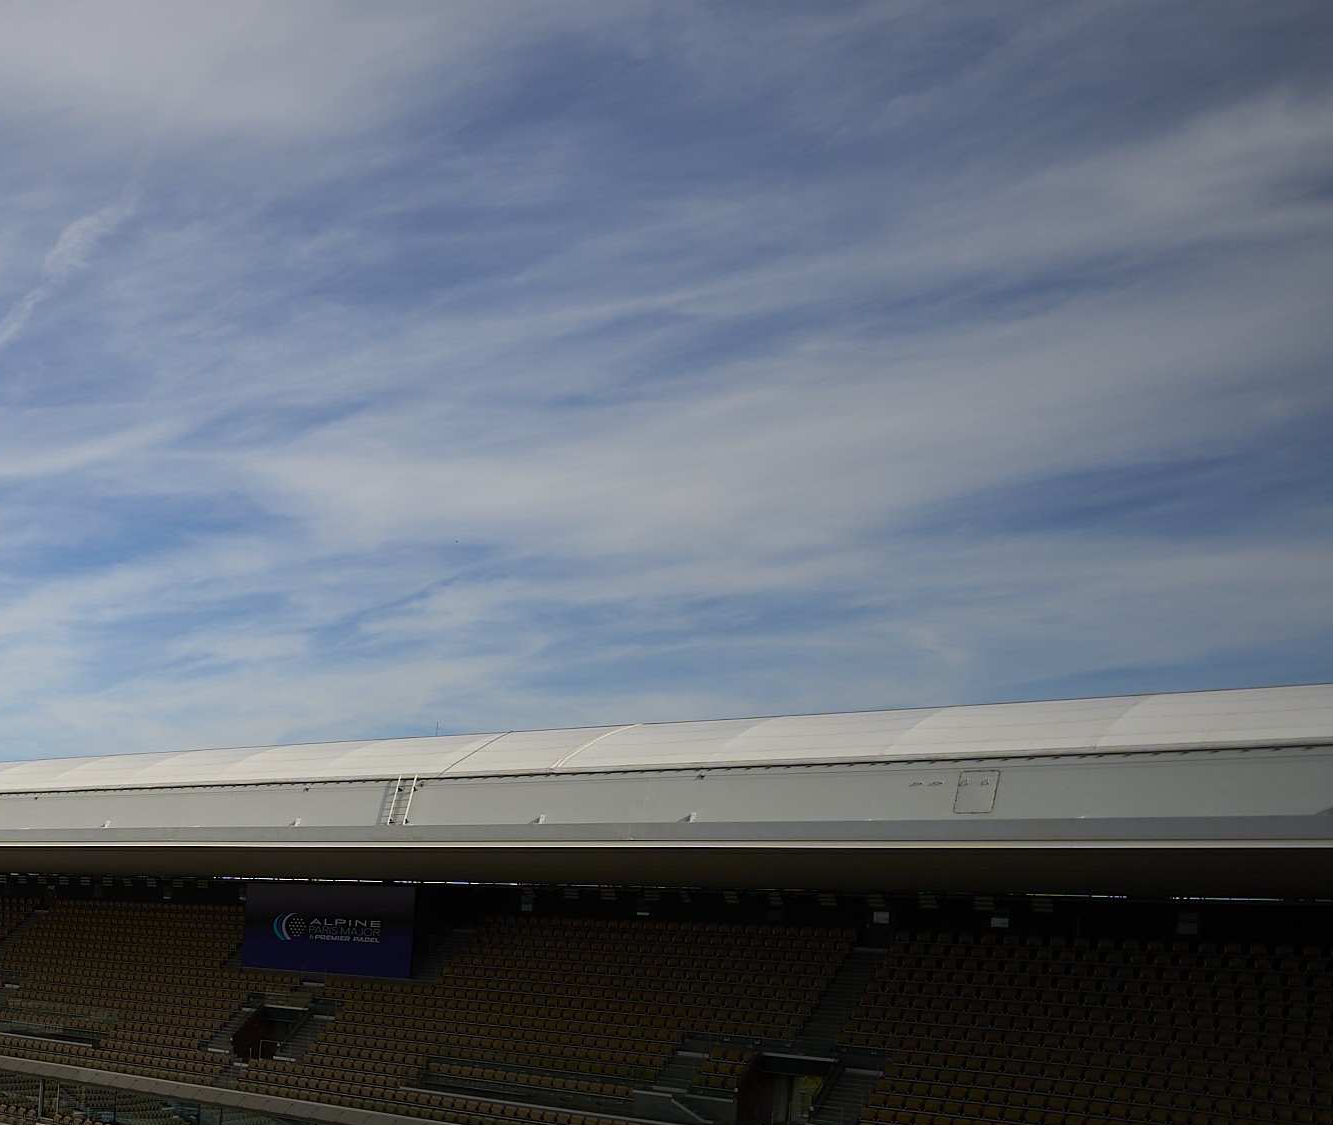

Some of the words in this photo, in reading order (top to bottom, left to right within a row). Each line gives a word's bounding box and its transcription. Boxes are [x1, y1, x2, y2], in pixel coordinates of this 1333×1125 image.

[309, 917, 382, 928] ALPINE
[308, 926, 339, 935] PARIS
[339, 926, 381, 937] MAJOR
[314, 934, 351, 942] PREMIER
[352, 936, 380, 944] PADEL
